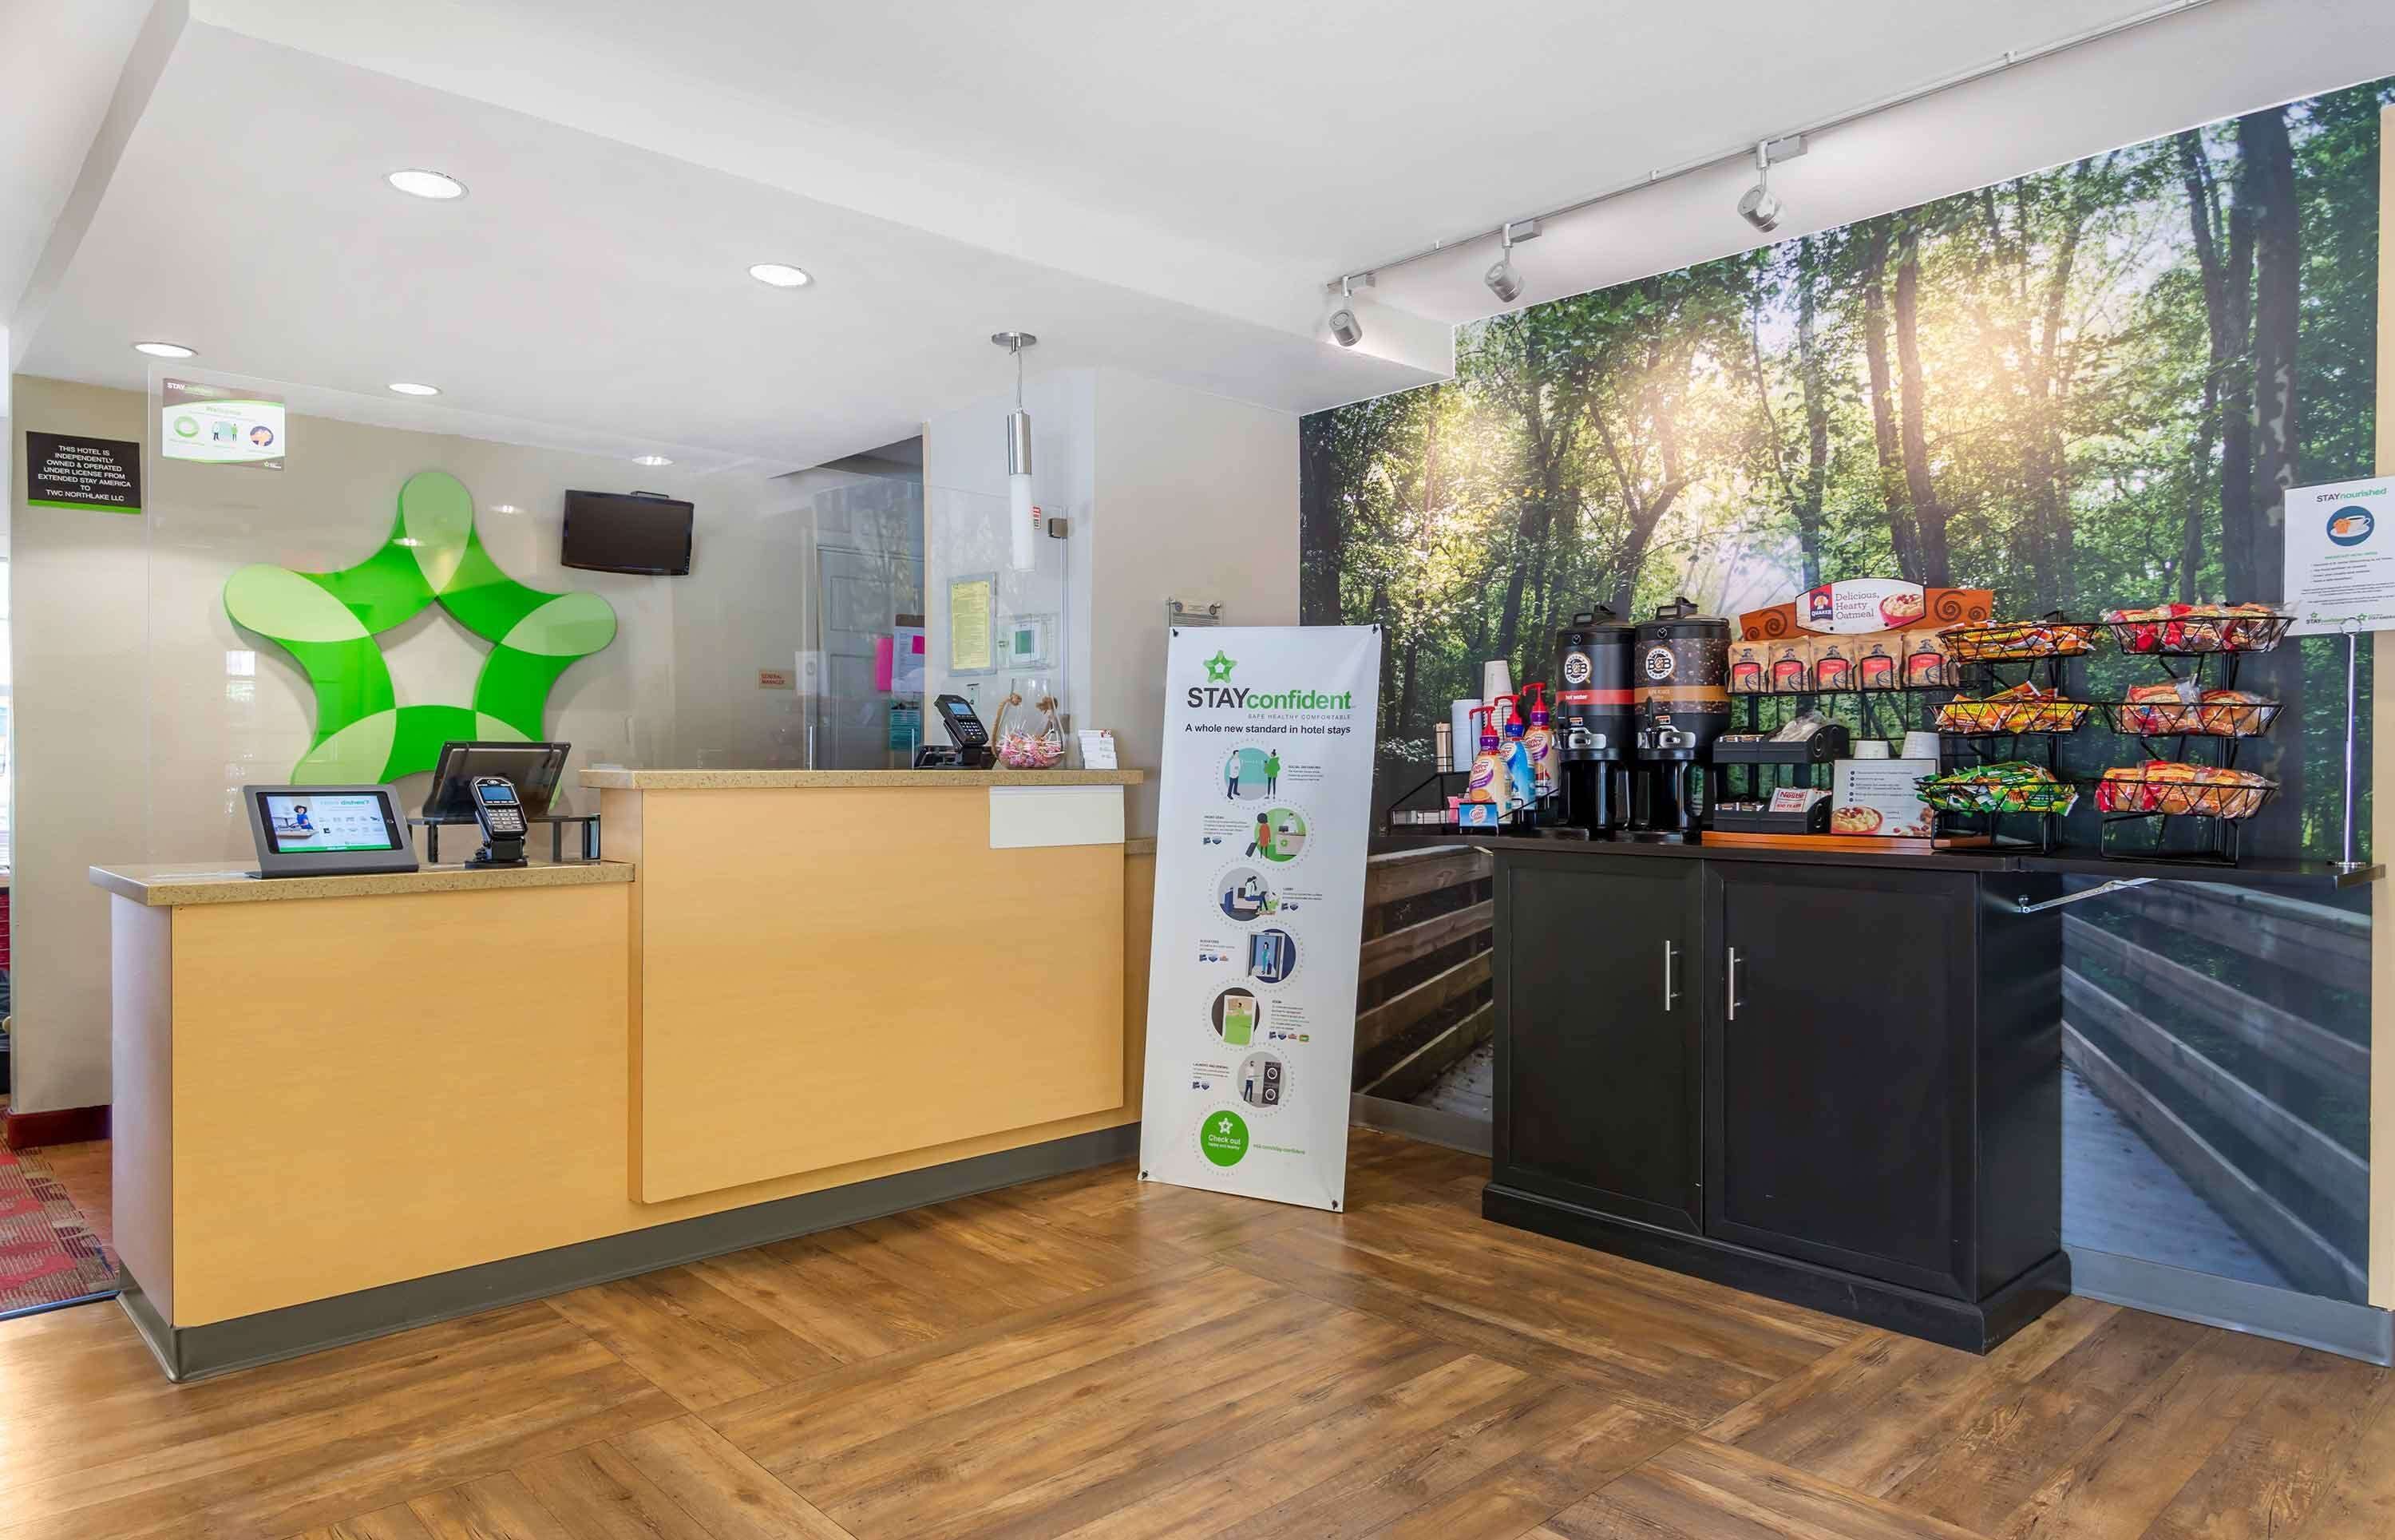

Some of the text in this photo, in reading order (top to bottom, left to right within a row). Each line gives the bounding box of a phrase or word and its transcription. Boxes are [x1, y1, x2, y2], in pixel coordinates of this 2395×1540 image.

[55, 453, 113, 463] INDEPENDENTLY
[83, 463, 122, 472] OPERATED
[38, 473, 78, 482] EXTENDED
[65, 491, 109, 501] NORTHLAKE
[1835, 591, 1880, 601] Delicious,
[1835, 602, 1868, 612] Hearty
[1835, 608, 1874, 620] Oatmeal
[1187, 687, 1352, 710] STAYconfident
[1185, 723, 1193, 733] A
[1195, 724, 1221, 733] whole
[1246, 724, 1286, 734] standard
[1289, 724, 1298, 734] in
[1301, 725, 1324, 734] hotel
[1328, 726, 1351, 735] stays
[1208, 1134, 1229, 1143] Check
